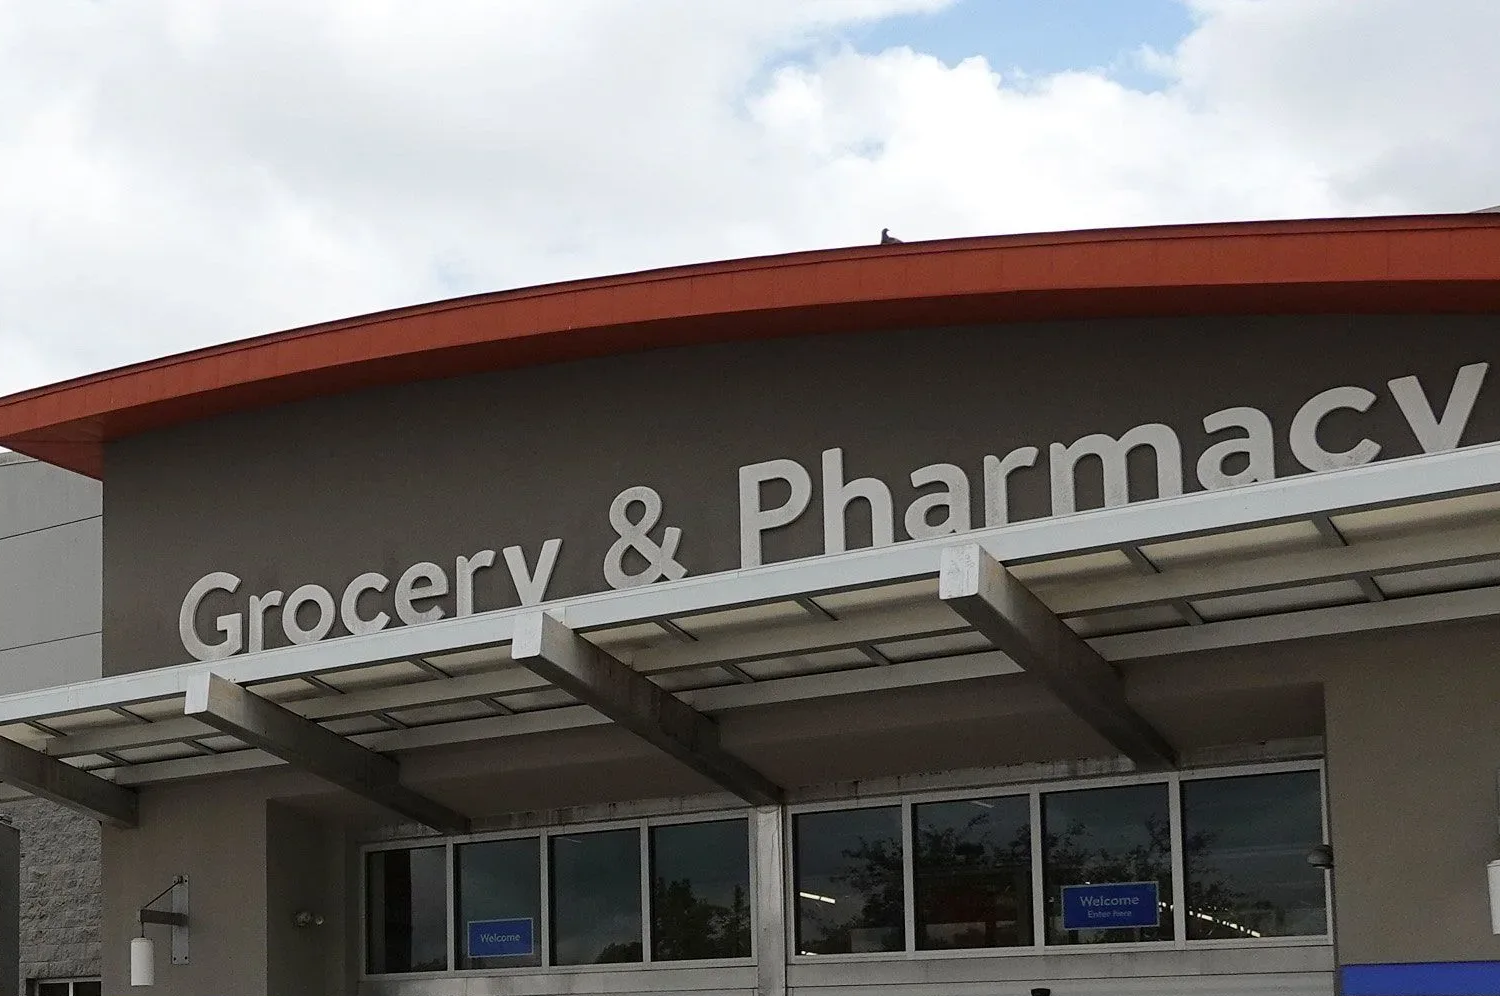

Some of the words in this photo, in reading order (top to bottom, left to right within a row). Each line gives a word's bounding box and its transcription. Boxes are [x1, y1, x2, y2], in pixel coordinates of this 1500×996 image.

[179, 538, 563, 660] Grocery
[603, 486, 688, 590] &
[739, 361, 1489, 568] Pharmacy
[1080, 896, 1140, 907] Welcome
[480, 933, 521, 943] Welcome
